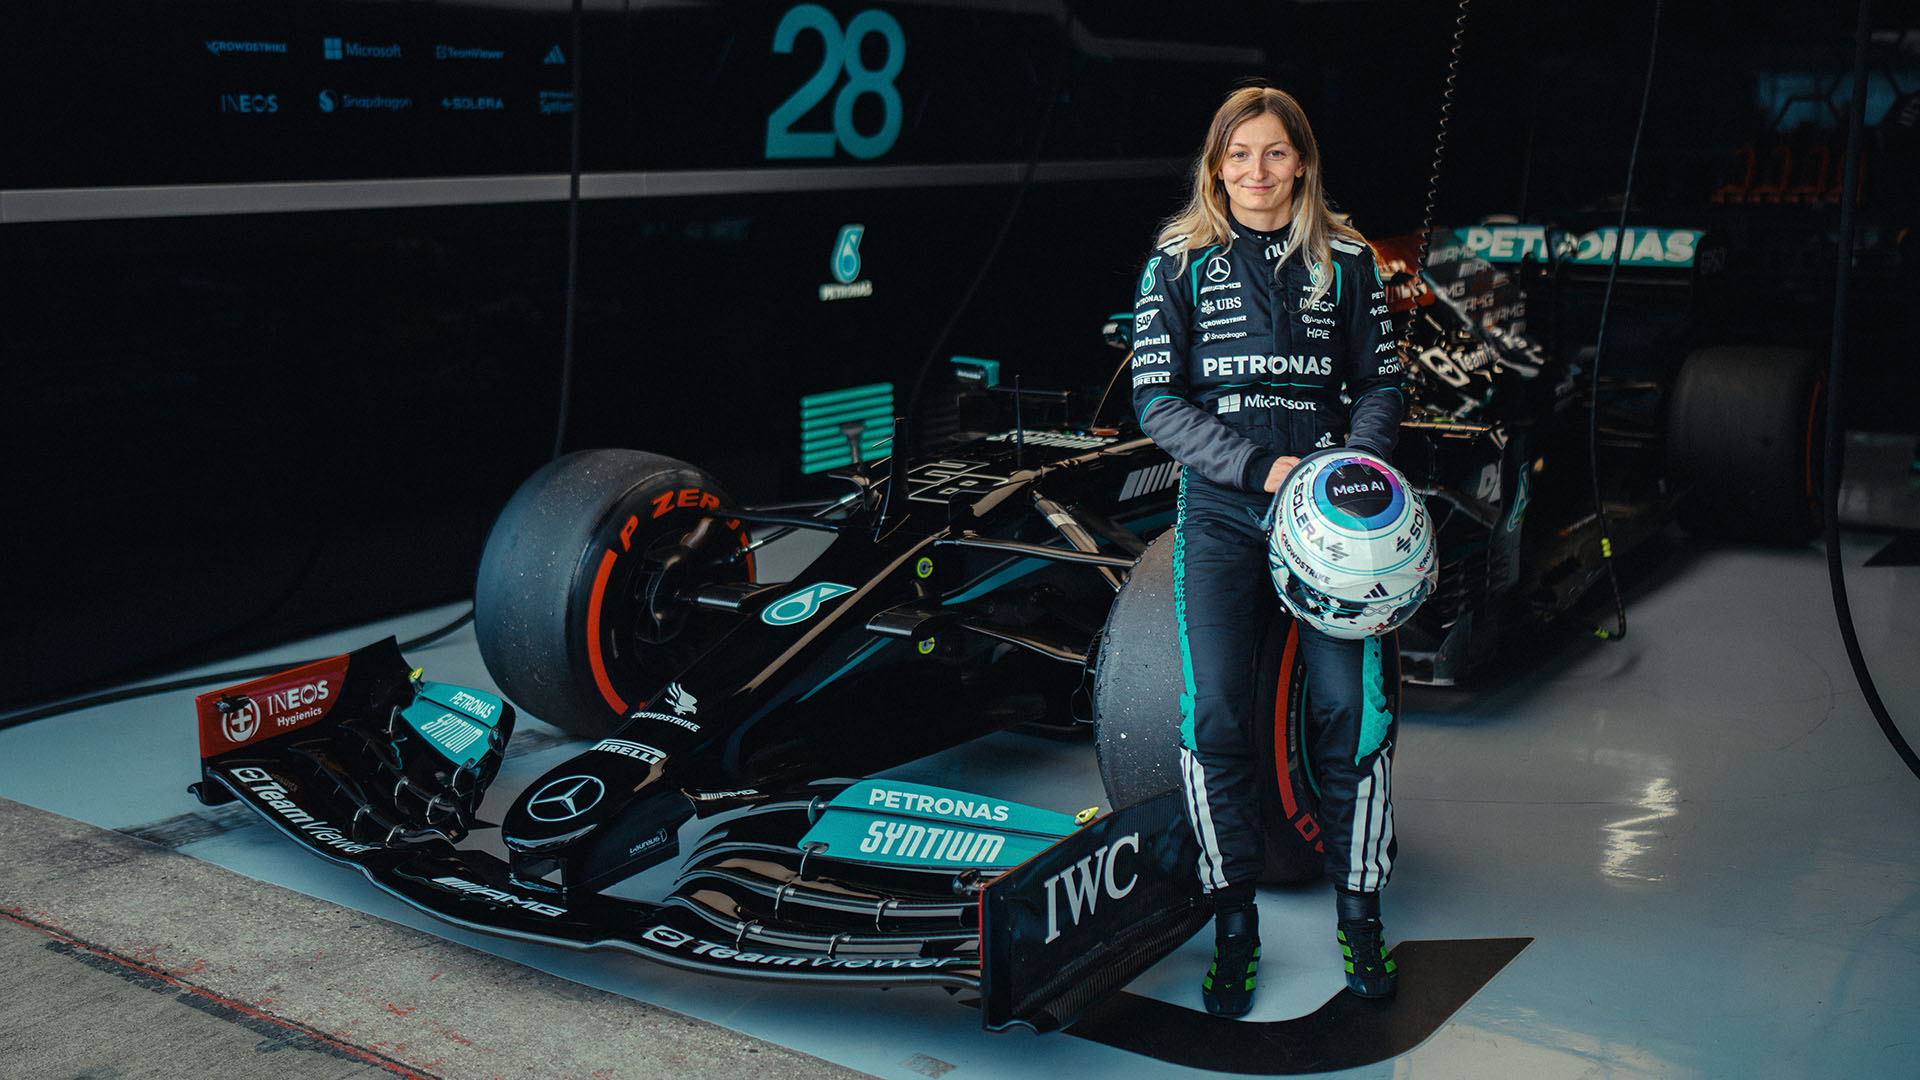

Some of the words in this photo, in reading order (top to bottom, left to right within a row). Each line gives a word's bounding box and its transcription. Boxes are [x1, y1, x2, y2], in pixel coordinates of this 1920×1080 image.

[211, 40, 288, 54] CROWDSTRIKE
[345, 41, 401, 57] Microsoft
[448, 47, 504, 61] TeamViewer
[763, 2, 908, 161] 28
[219, 92, 280, 113] INEOS
[342, 93, 413, 112] Snapdragon
[452, 97, 505, 111] SOLERA
[1465, 227, 1698, 263] PETONAS
[1135, 295, 1164, 310] PETRONAS
[1215, 296, 1243, 311] UBS
[1377, 305, 1390, 315] SO
[1137, 314, 1154, 329] SAP
[1203, 315, 1247, 328] CROWDSTRIKE
[1210, 331, 1248, 341] Snapdragon
[1306, 327, 1331, 340] HPE
[1131, 352, 1158, 370] AMD
[1202, 355, 1333, 377] PETRONAS
[1244, 393, 1318, 412] Microsoft
[1332, 482, 1369, 497] Meta
[1370, 480, 1386, 491] AI
[1292, 481, 1326, 552] SOLERA
[619, 514, 639, 553] P
[1283, 533, 1331, 585] CROWDSTRIKE
[267, 680, 330, 716] INEOS
[449, 691, 496, 719] PETRONAS
[277, 706, 323, 728] Hygienics
[631, 711, 702, 733] CROWDSTRIKE
[420, 713, 484, 754] SYNTIUM
[589, 738, 668, 766] PIRELLI
[868, 788, 1010, 822] PETRONAS
[250, 780, 382, 854] TeamViewer
[859, 820, 1006, 864] SYNTIUM
[1043, 831, 1140, 945] IWC
[691, 939, 962, 969] TeamViewer
